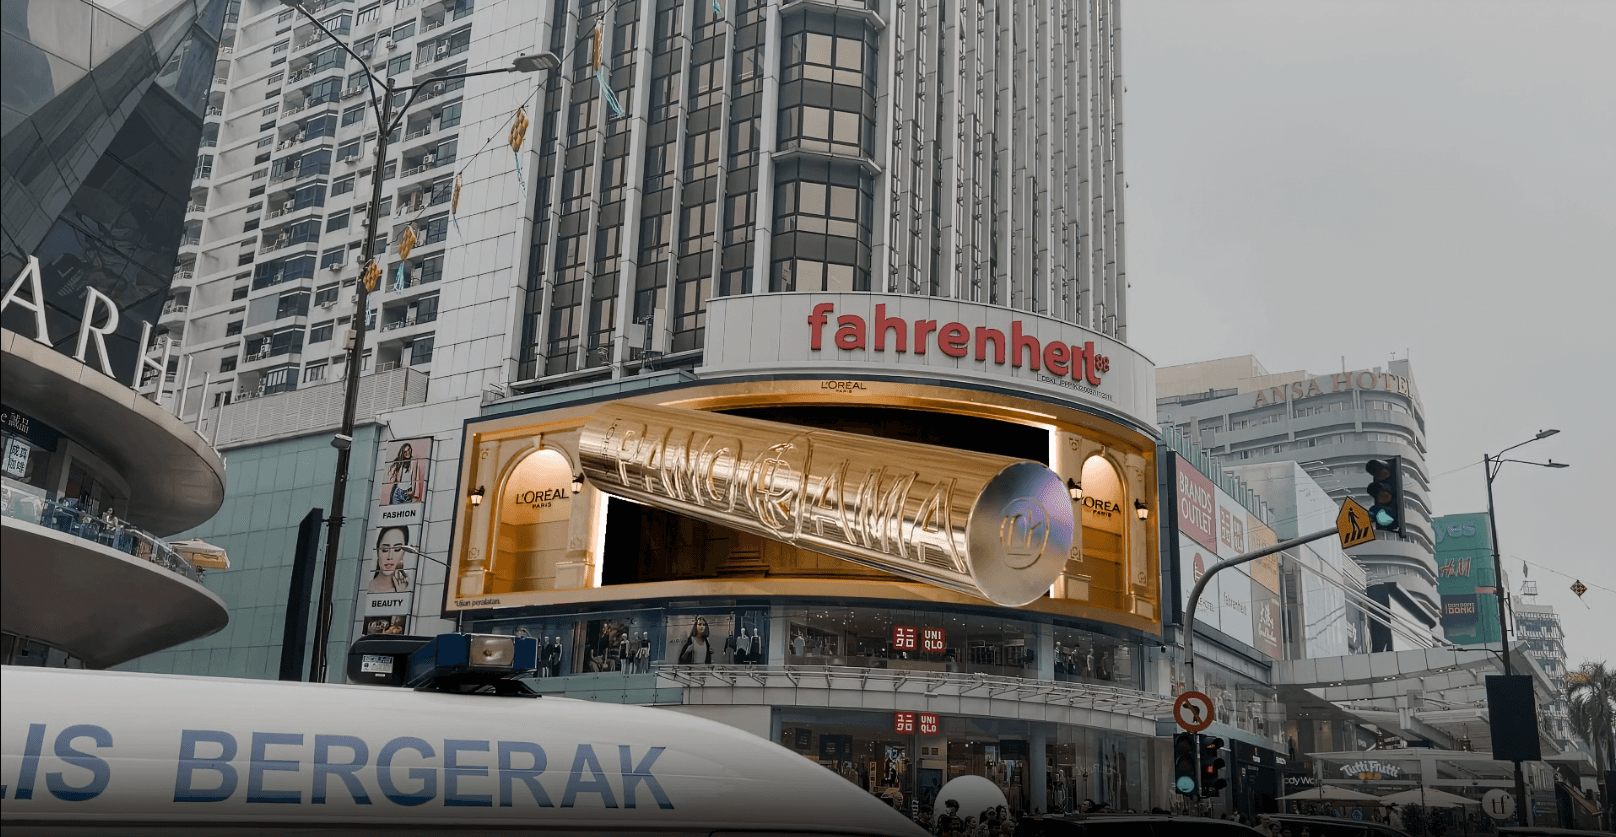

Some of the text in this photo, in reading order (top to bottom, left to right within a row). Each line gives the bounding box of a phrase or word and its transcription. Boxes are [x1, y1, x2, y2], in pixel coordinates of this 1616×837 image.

[1254, 371, 1414, 407] ANSA HOTEL
[1179, 470, 1212, 514] BRANDS
[382, 510, 416, 519] FASHION
[1181, 497, 1212, 536] OUTLET
[1435, 521, 1476, 543] yes
[371, 599, 404, 608] BEAUTY
[0, 723, 675, 811] IS BERGERAK
[1340, 760, 1401, 778] Tutti Frutti
[1284, 776, 1300, 786] ody
